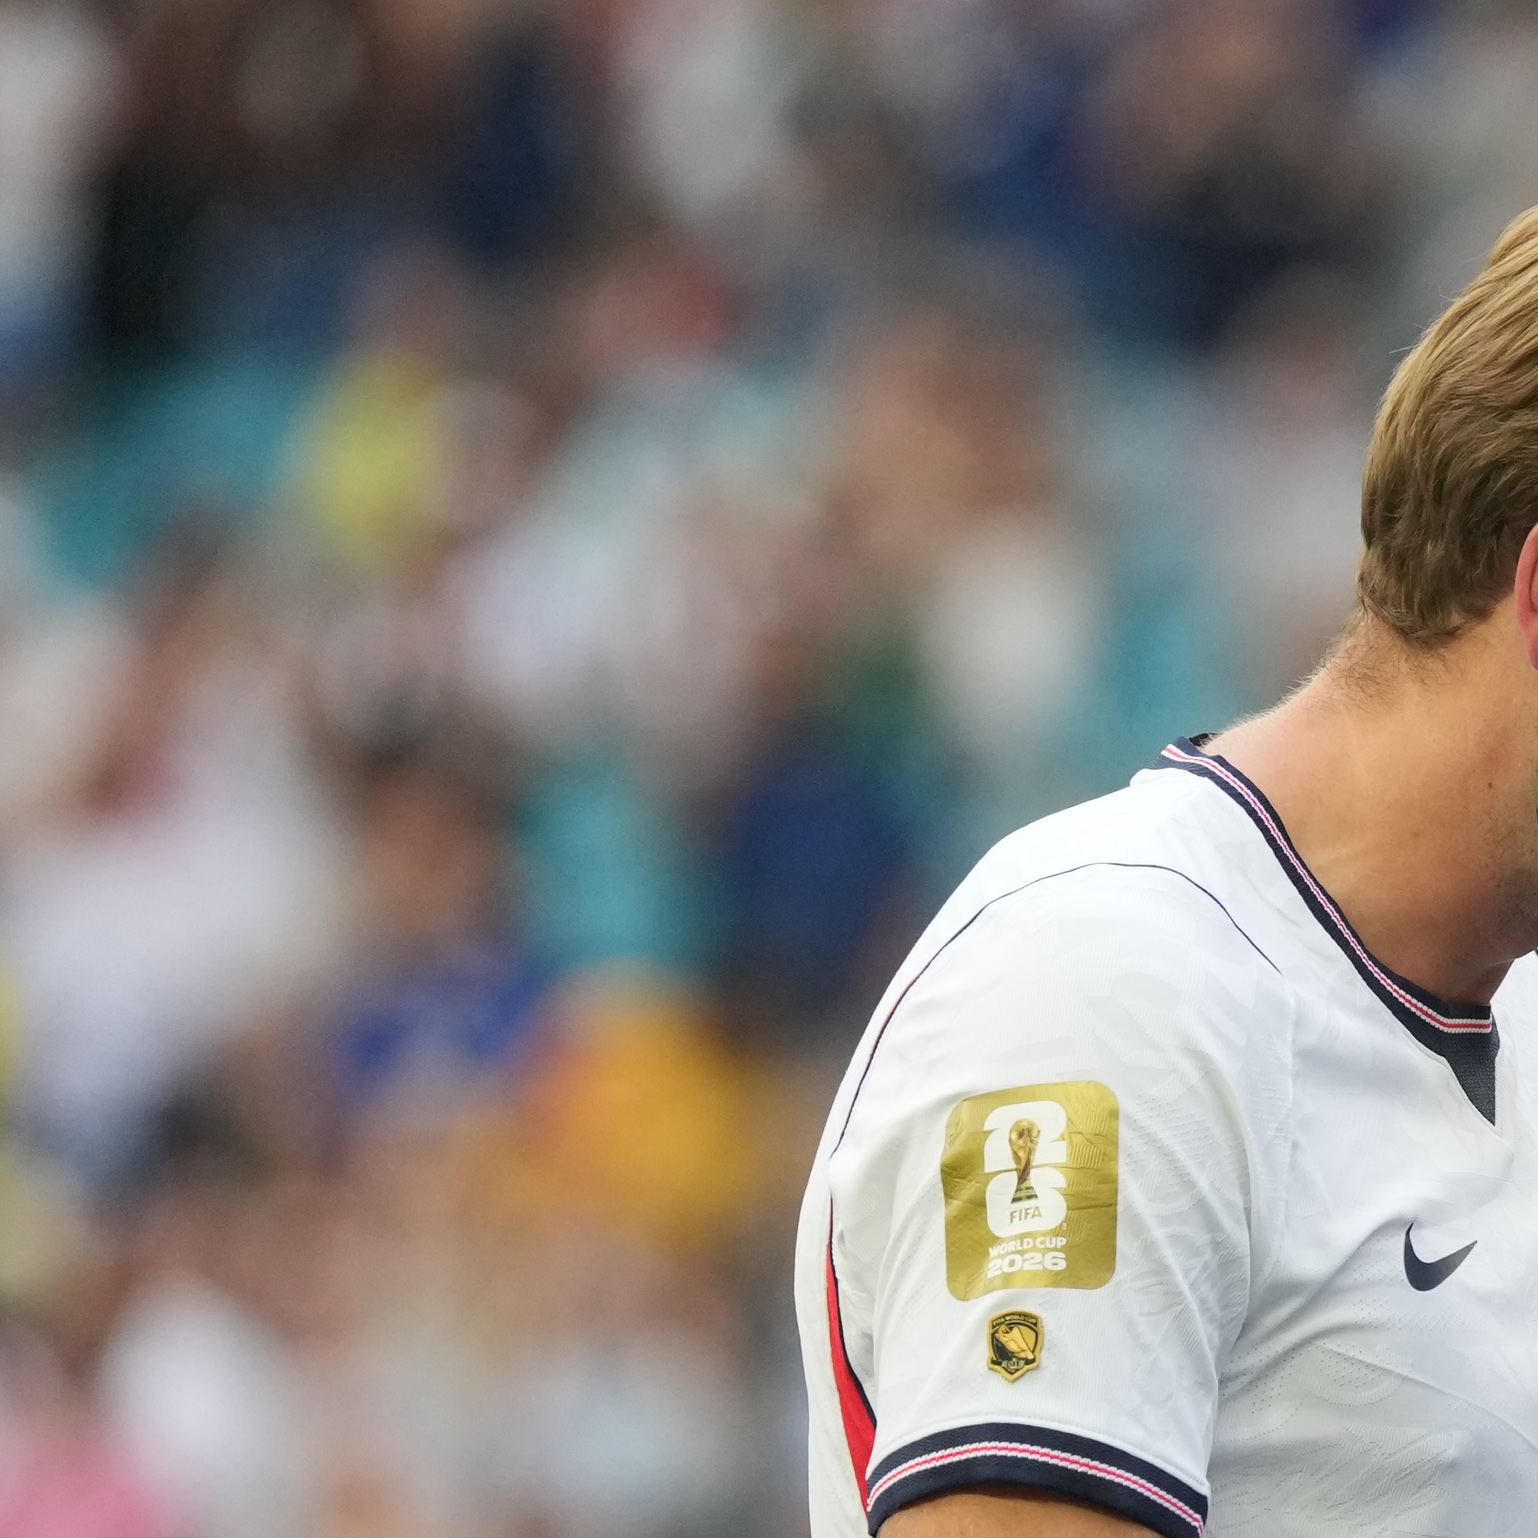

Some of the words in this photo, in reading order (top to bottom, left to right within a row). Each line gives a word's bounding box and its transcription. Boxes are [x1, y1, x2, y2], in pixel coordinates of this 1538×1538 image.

[1010, 1206, 1042, 1224] FIFA
[988, 1237, 1034, 1258] WORLD
[1035, 1236, 1067, 1249] CUP
[986, 1251, 1067, 1279] 2026
